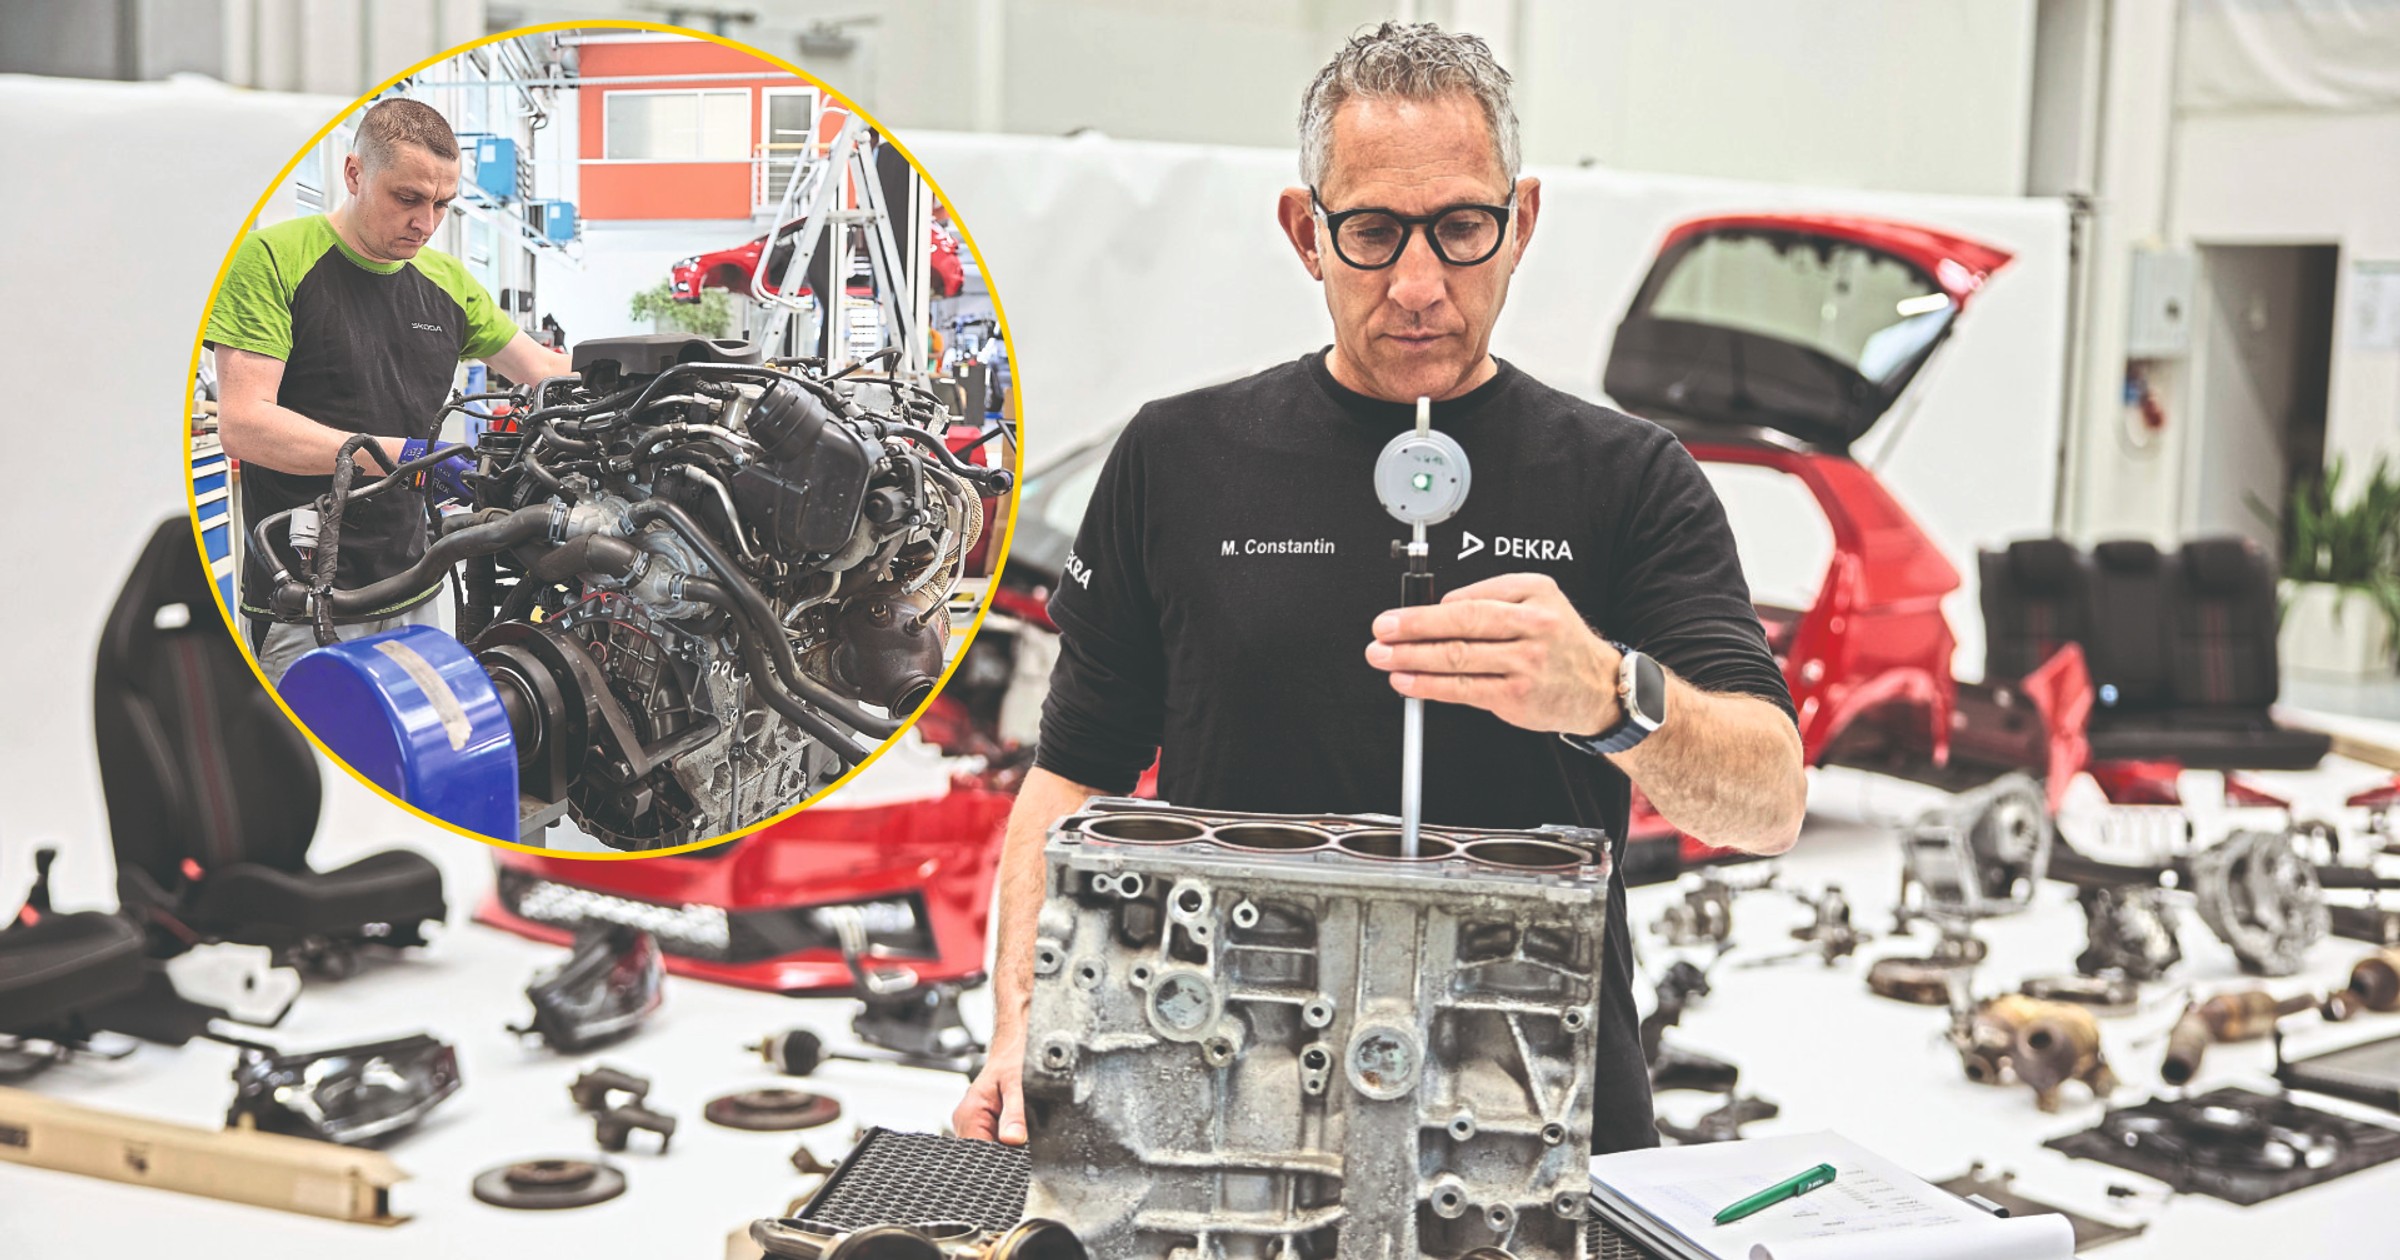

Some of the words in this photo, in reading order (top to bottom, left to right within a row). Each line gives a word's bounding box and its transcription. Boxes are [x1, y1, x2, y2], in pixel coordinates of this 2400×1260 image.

[1221, 540, 1239, 556] M.
[1244, 538, 1335, 555] Constantin
[1494, 536, 1574, 561] DEKRA
